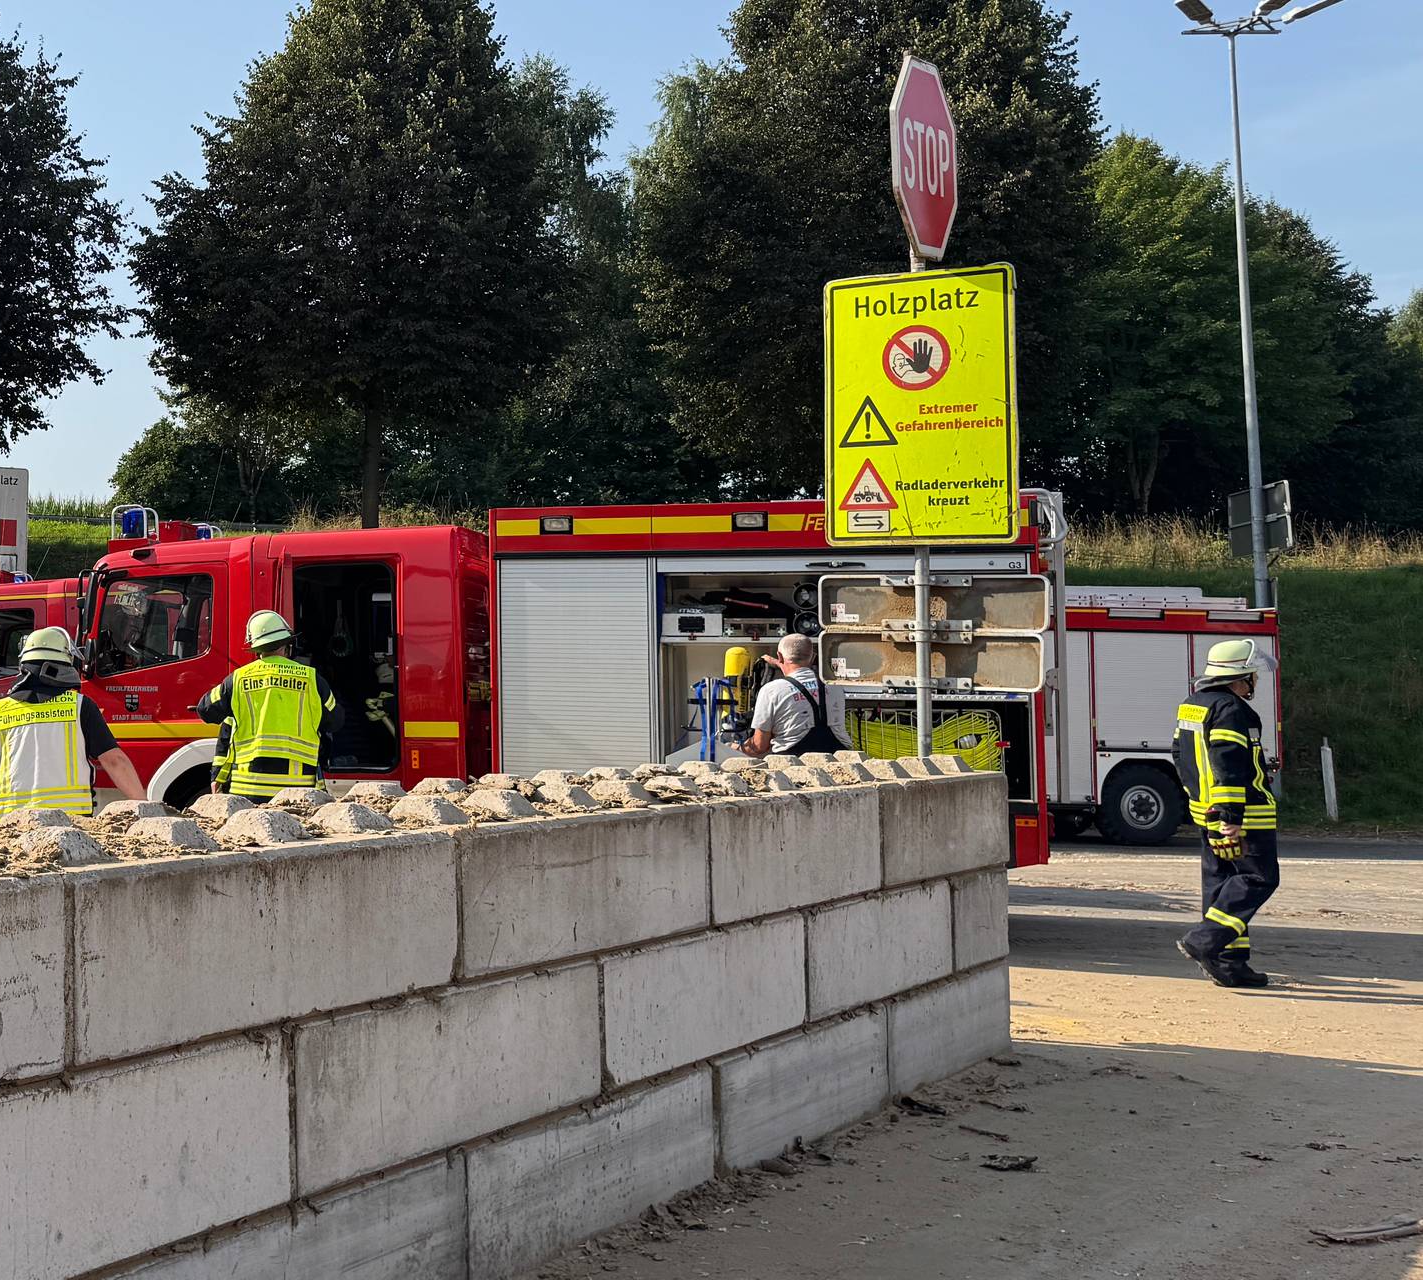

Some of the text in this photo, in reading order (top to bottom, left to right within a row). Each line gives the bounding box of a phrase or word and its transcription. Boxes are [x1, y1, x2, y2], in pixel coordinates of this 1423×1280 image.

[903, 117, 950, 198] STOP
[854, 287, 980, 319] Holzplatz
[919, 403, 979, 415] Extremer
[895, 416, 1004, 432] Gefahrenbereich
[895, 477, 1005, 491] Radladerverkehr
[928, 495, 970, 506] kreuzt
[1008, 561, 1022, 569] G3
[243, 676, 307, 690] Einsatzleiter
